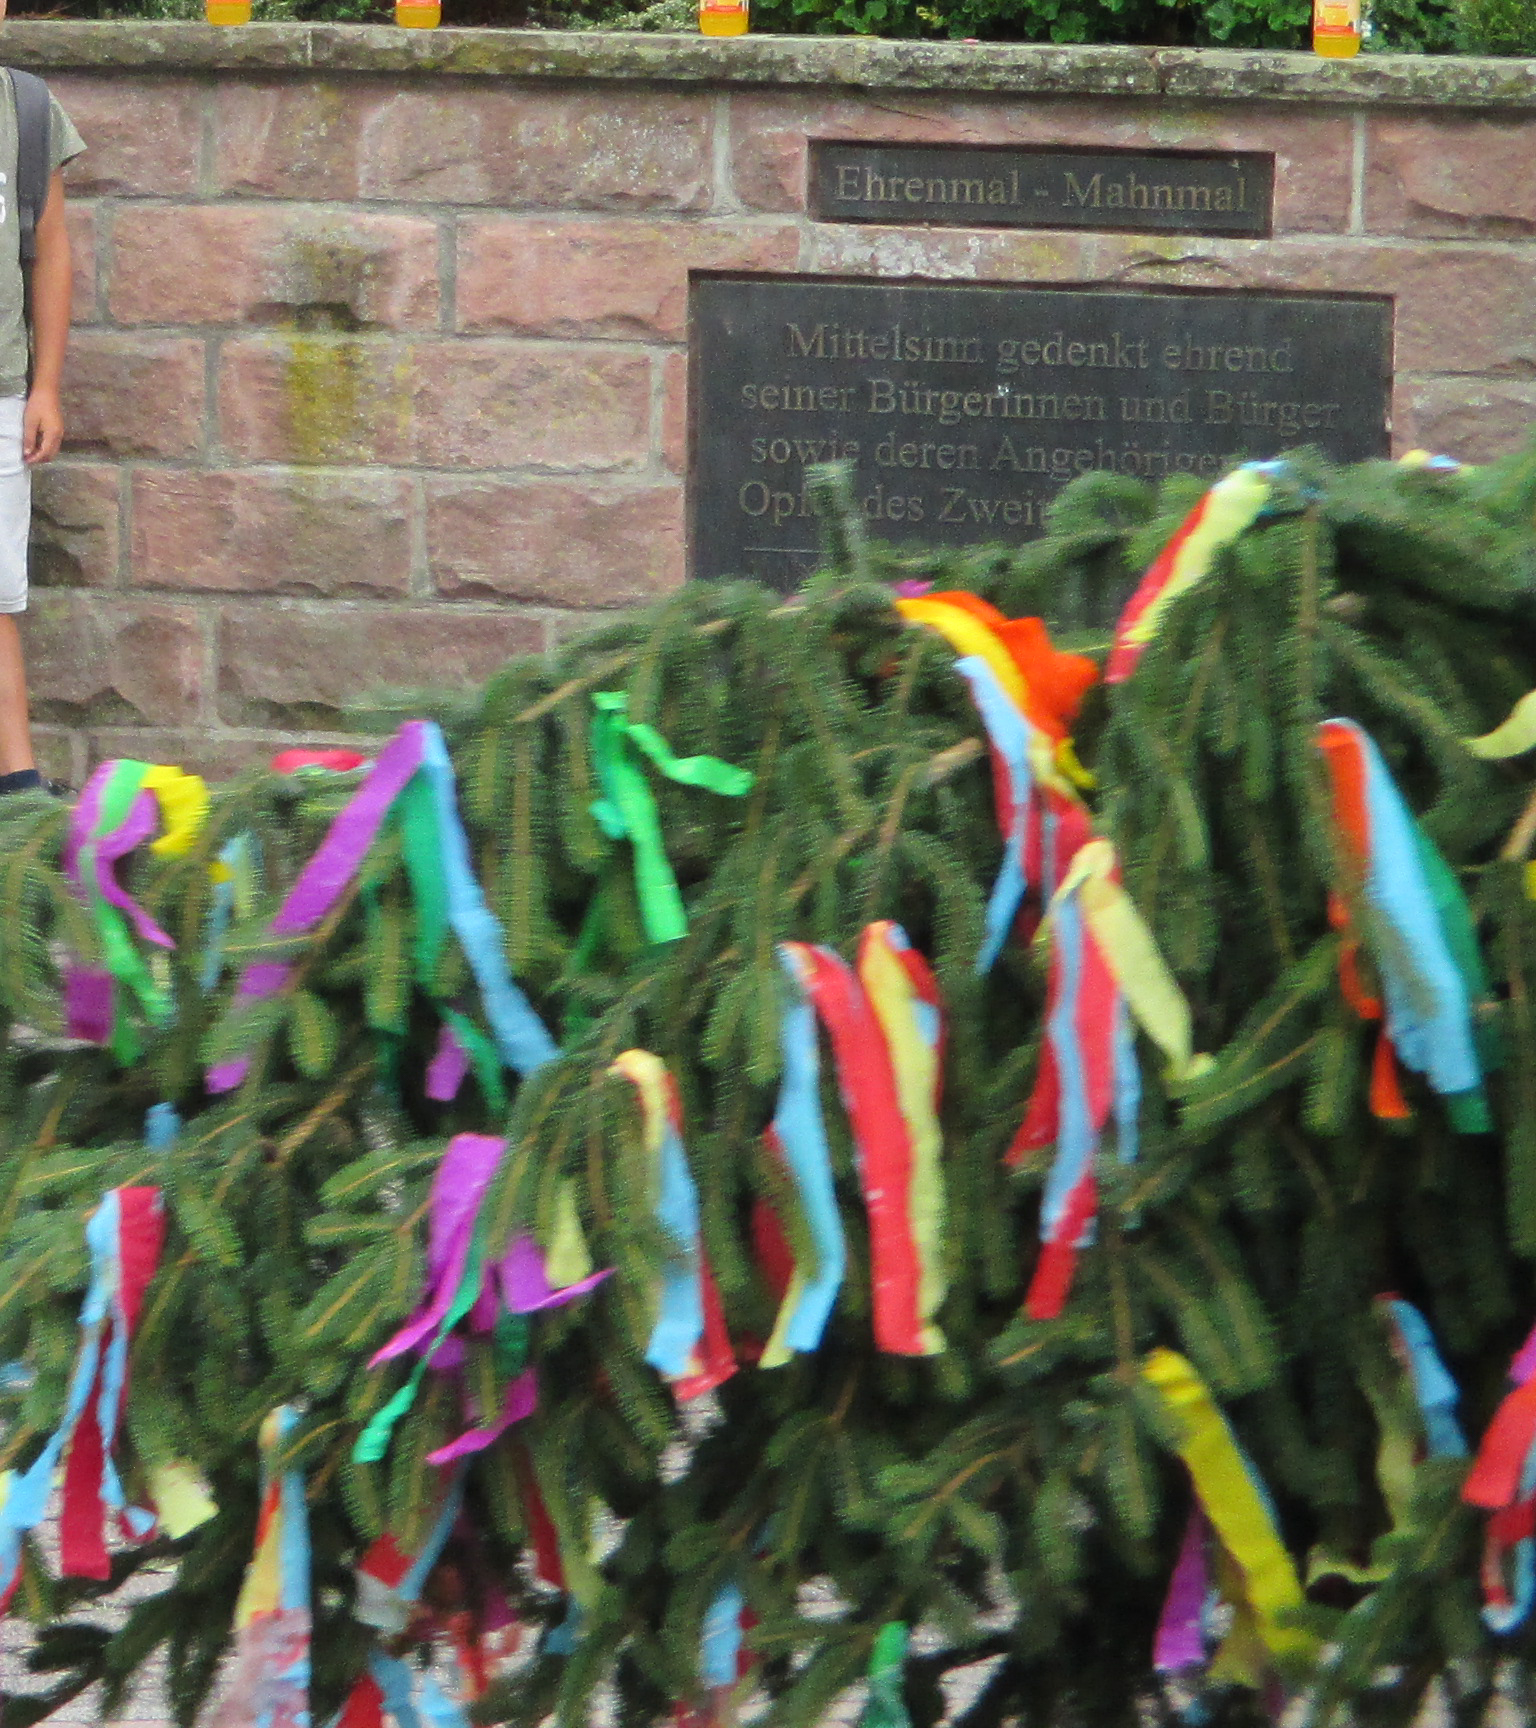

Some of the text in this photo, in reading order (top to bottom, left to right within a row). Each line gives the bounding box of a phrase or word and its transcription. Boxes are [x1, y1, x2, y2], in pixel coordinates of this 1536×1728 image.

[836, 165, 1022, 204] Ehrenmal
[1063, 171, 1247, 212] Mahnmal
[786, 321, 1294, 374] Mittelsinn gedenkt ehrend
[741, 374, 1342, 438] seiner Bürgerinnen und Bürger
[751, 429, 860, 464] sowie
[875, 431, 978, 470] deren
[864, 484, 925, 522] des
